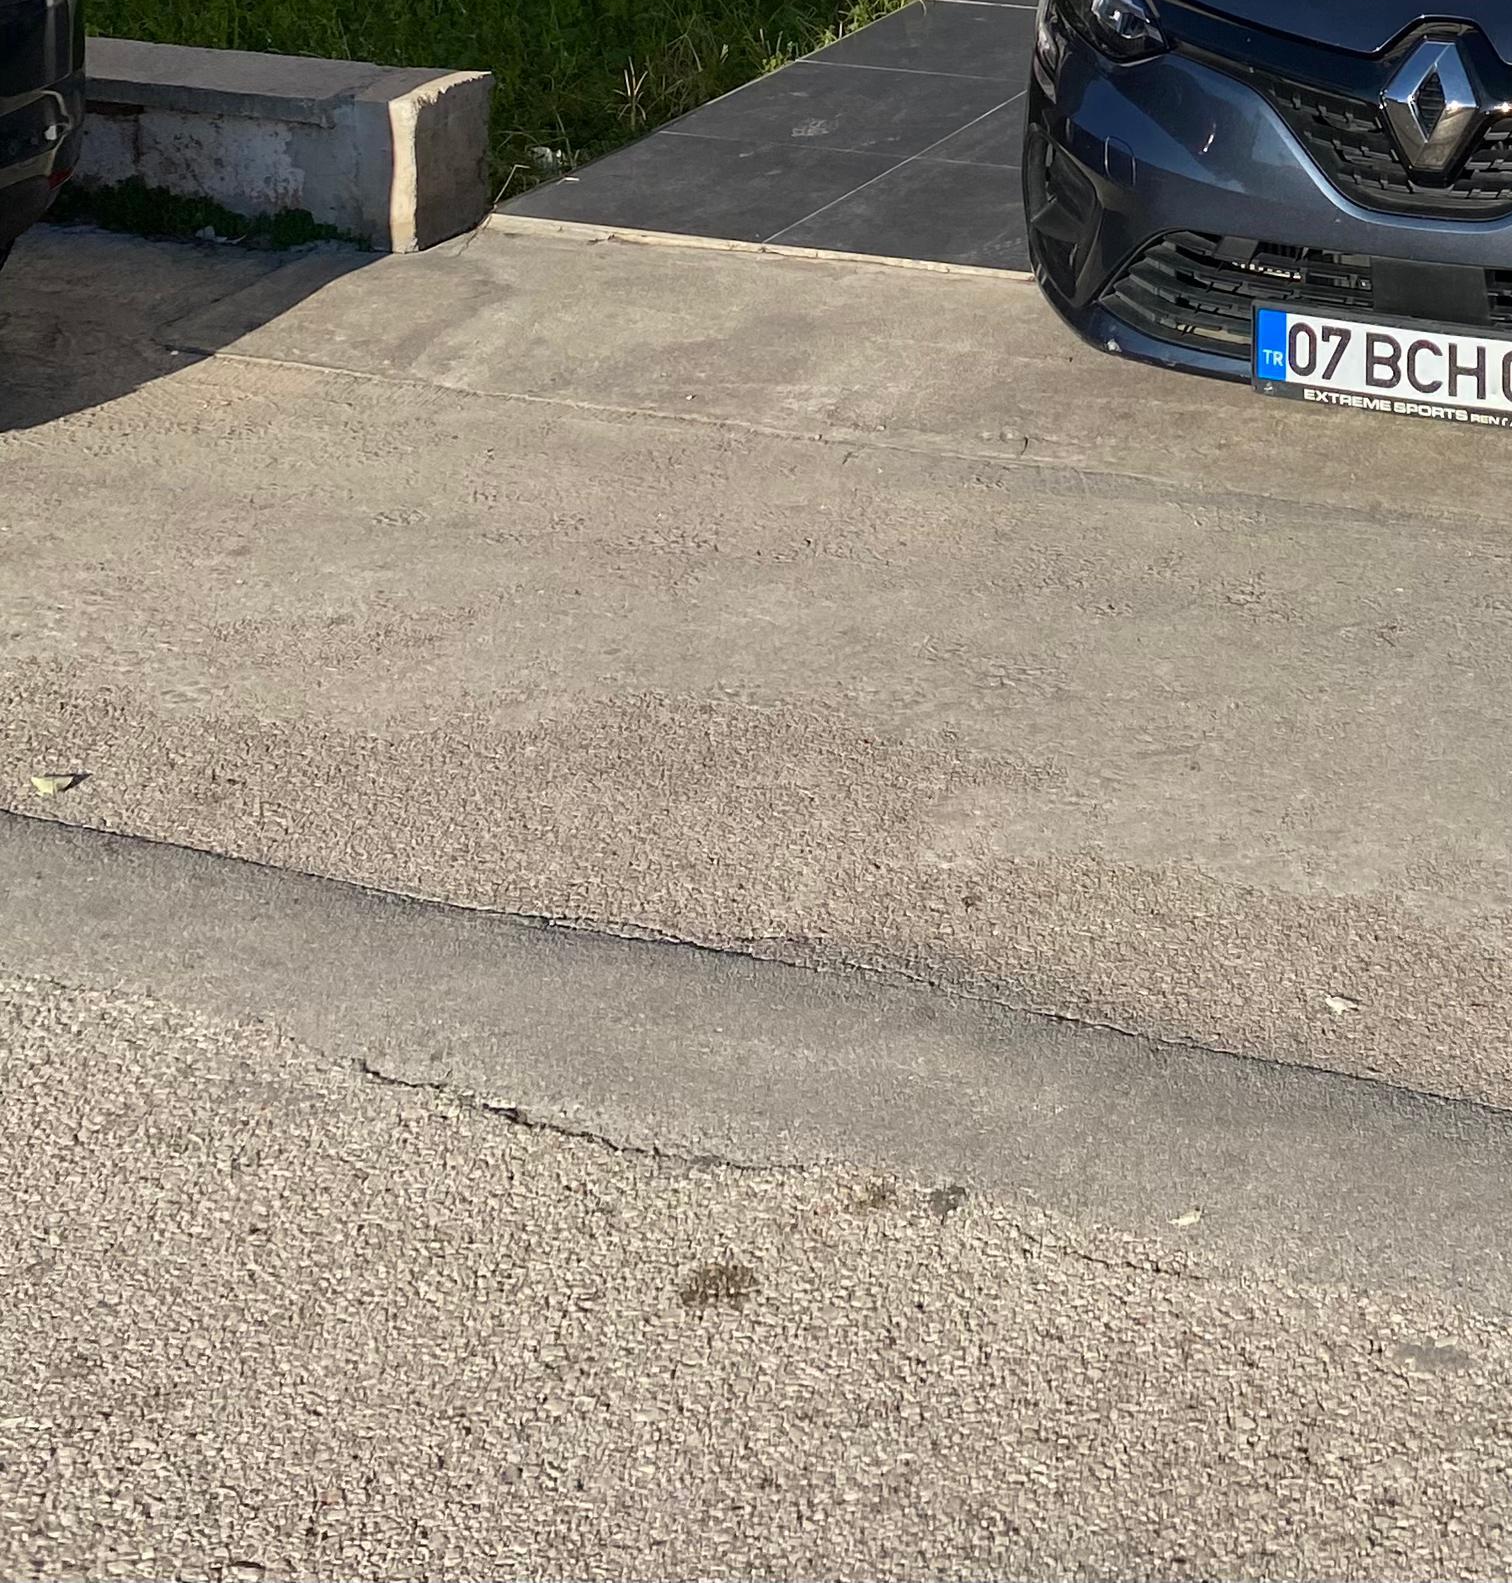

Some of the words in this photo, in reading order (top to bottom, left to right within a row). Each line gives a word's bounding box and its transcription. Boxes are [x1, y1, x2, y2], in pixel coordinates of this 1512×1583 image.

[1262, 348, 1284, 367] TR
[1288, 321, 1352, 381] 07
[1364, 331, 1487, 401] BCH
[1303, 388, 1392, 412] EXTREME
[1393, 400, 1469, 422] SPORTS
